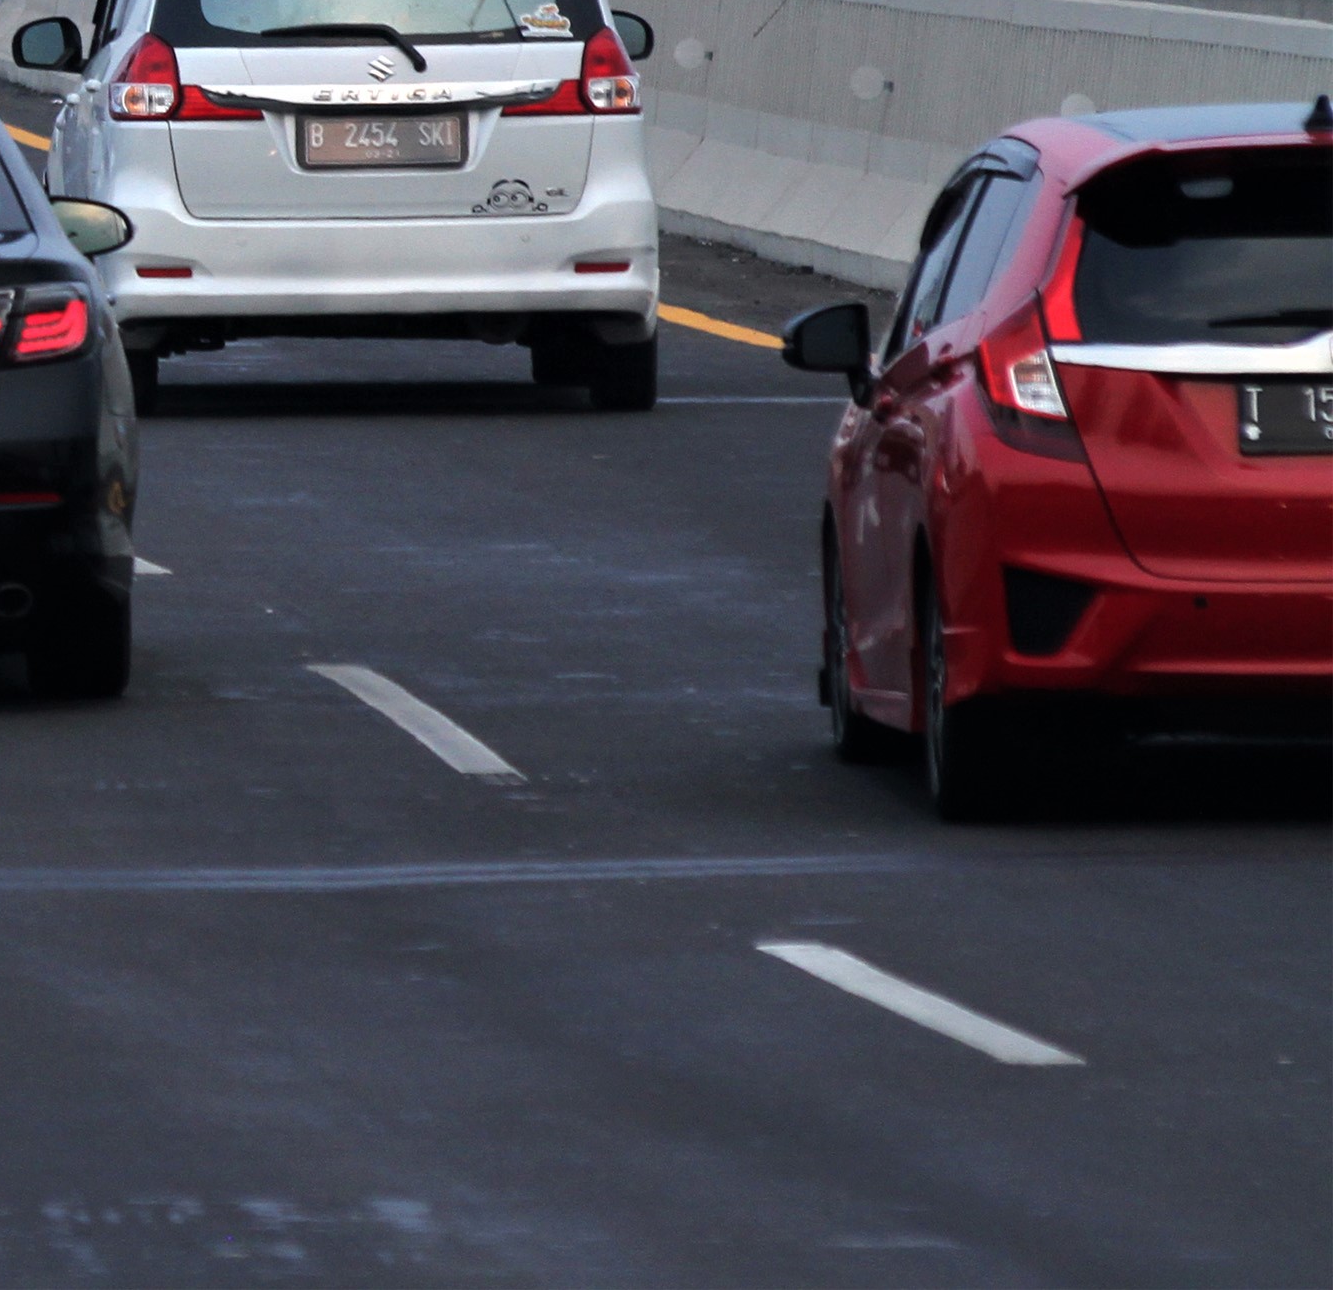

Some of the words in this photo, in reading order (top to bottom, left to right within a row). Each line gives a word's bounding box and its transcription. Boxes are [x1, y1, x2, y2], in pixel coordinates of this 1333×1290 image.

[311, 123, 324, 148] B
[345, 122, 398, 147] 2454
[418, 121, 453, 146] SKI
[1245, 386, 1263, 423] T
